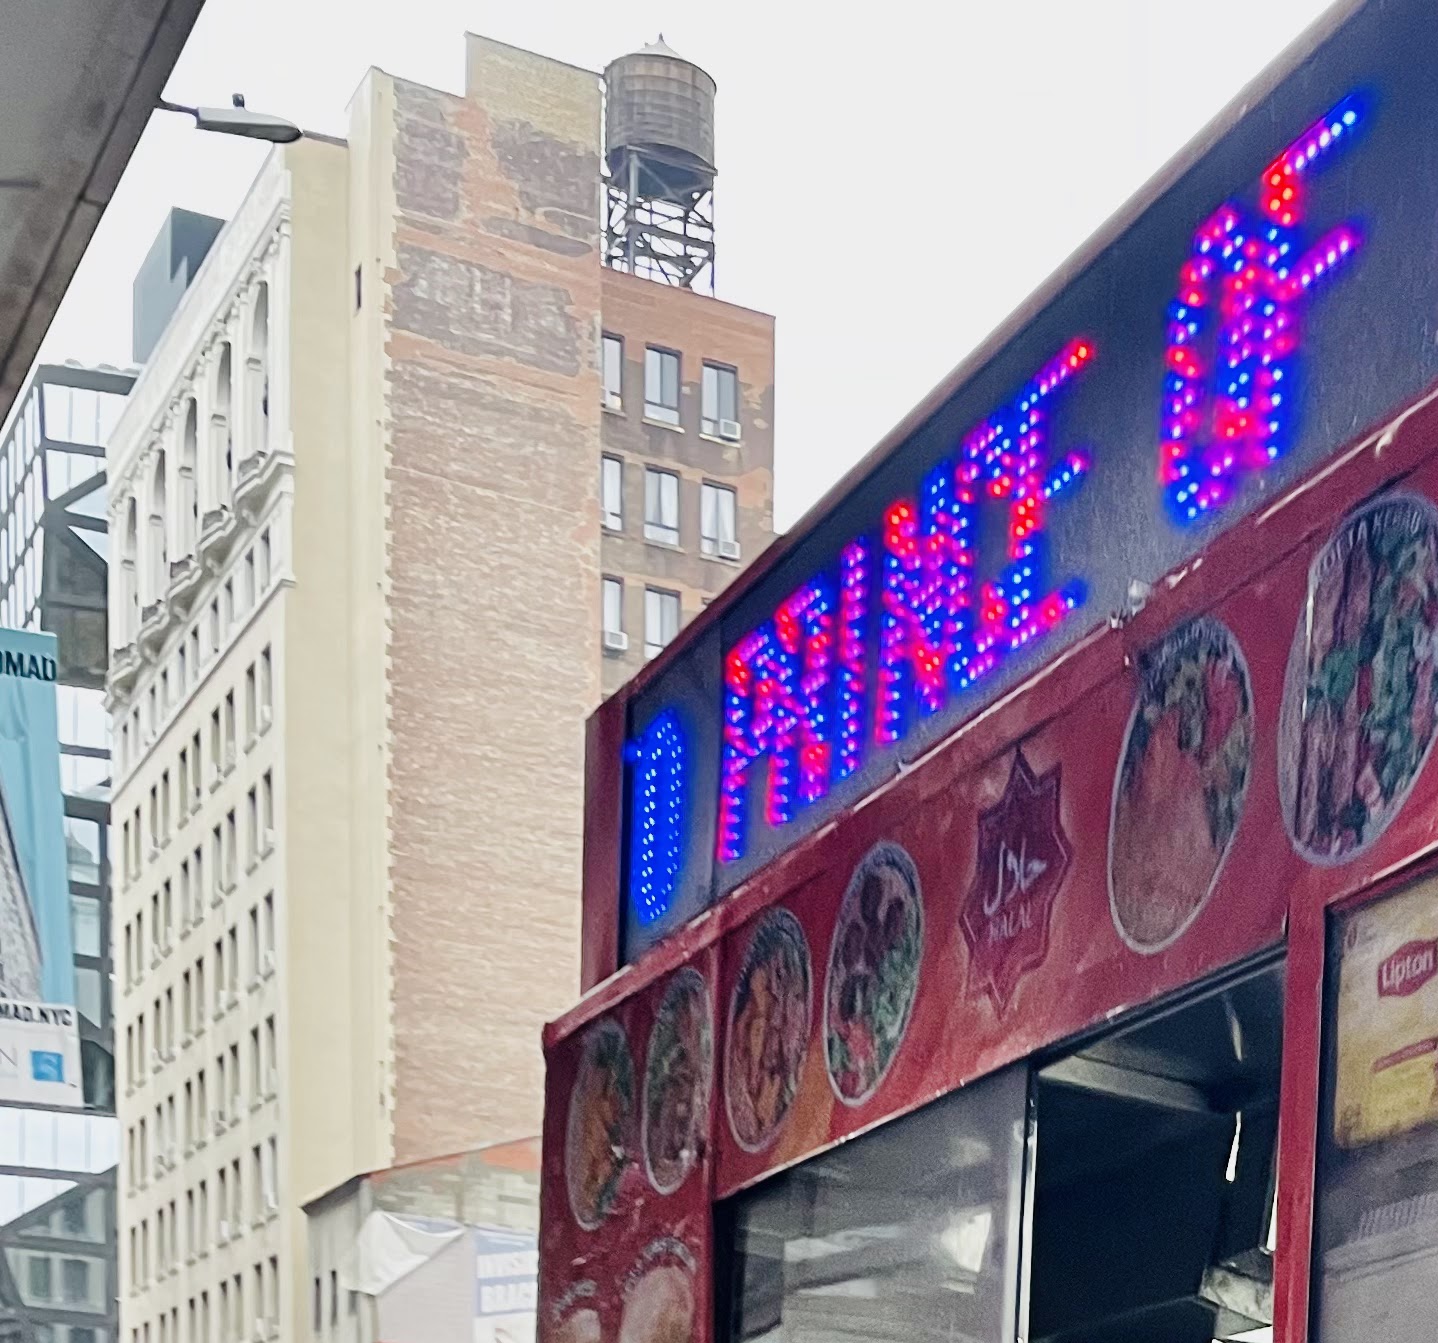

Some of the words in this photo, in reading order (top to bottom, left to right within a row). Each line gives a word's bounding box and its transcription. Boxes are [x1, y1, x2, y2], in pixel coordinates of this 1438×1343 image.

[1158, 91, 1372, 534] OF
[0, 650, 57, 682] MAD
[1382, 950, 1436, 993] Lipton
